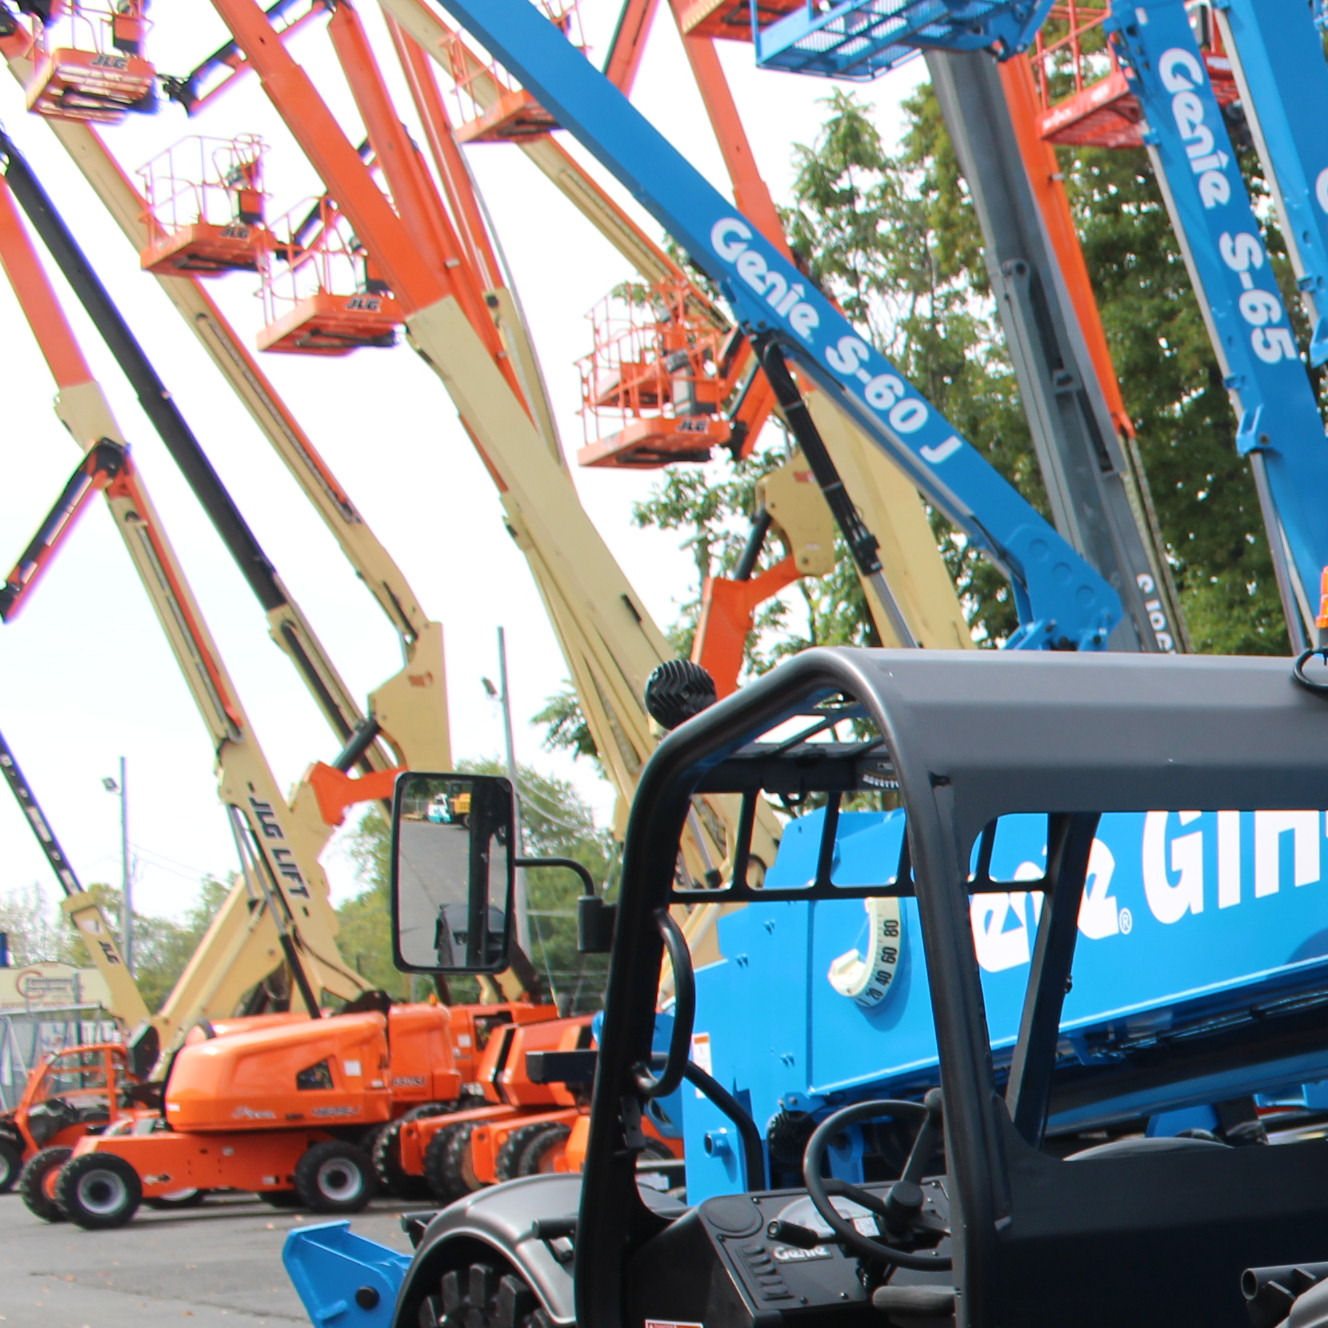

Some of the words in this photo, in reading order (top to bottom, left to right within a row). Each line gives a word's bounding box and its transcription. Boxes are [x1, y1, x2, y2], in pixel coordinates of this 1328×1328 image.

[91, 53, 129, 70] JLG
[1158, 47, 1231, 210] Genie
[1219, 231, 1298, 365] S-65
[219, 226, 250, 239] JLG
[345, 297, 381, 311] JLG
[710, 217, 820, 342] Genie
[825, 336, 928, 434] S-60
[919, 435, 963, 464] J
[676, 418, 708, 433] JLG
[249, 796, 285, 840] JLG
[271, 848, 311, 900] LIFT
[883, 919, 899, 938] 80
[881, 946, 898, 965] 60
[875, 970, 893, 986] 40
[772, 1245, 830, 1260] Genie
